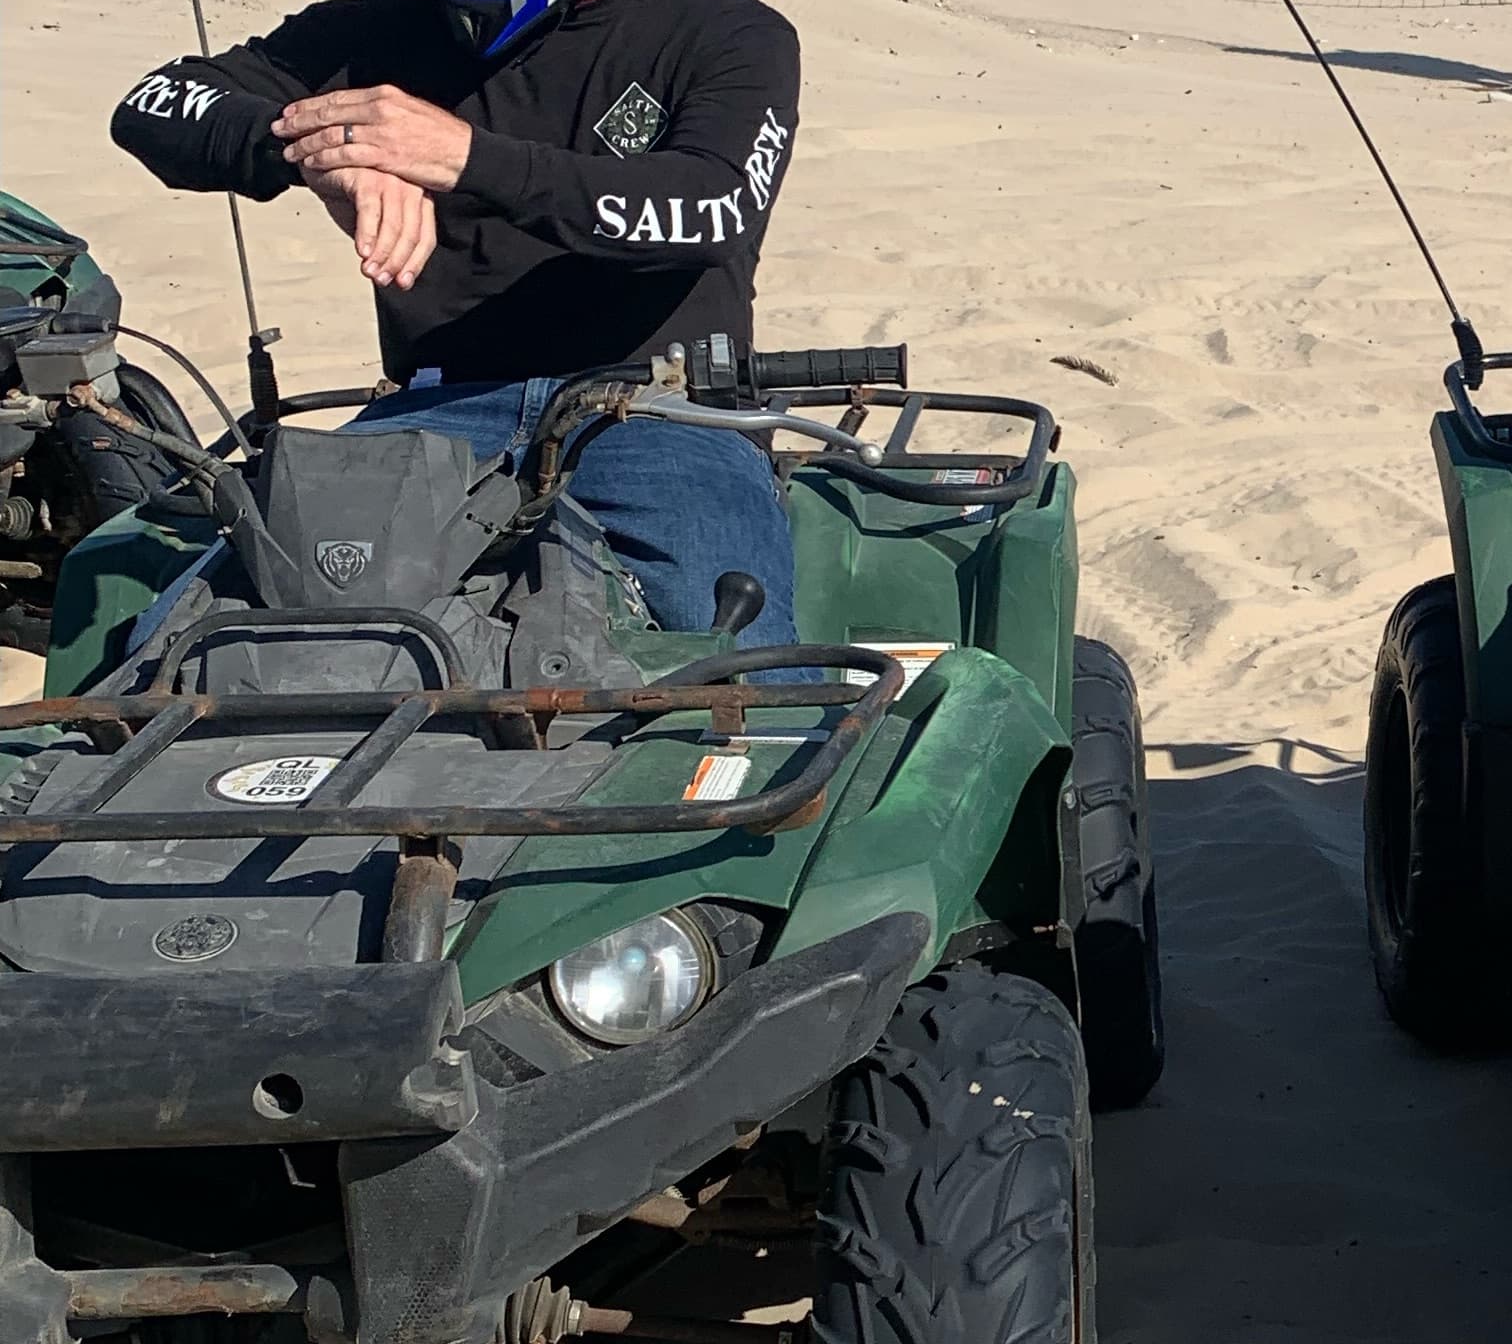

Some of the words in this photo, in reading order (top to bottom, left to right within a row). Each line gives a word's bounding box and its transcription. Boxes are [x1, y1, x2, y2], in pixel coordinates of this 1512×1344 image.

[126, 74, 230, 121] REW
[611, 133, 650, 148] CREW
[592, 187, 745, 243] SALTY
[275, 759, 320, 769] QL
[245, 786, 307, 796] 059
